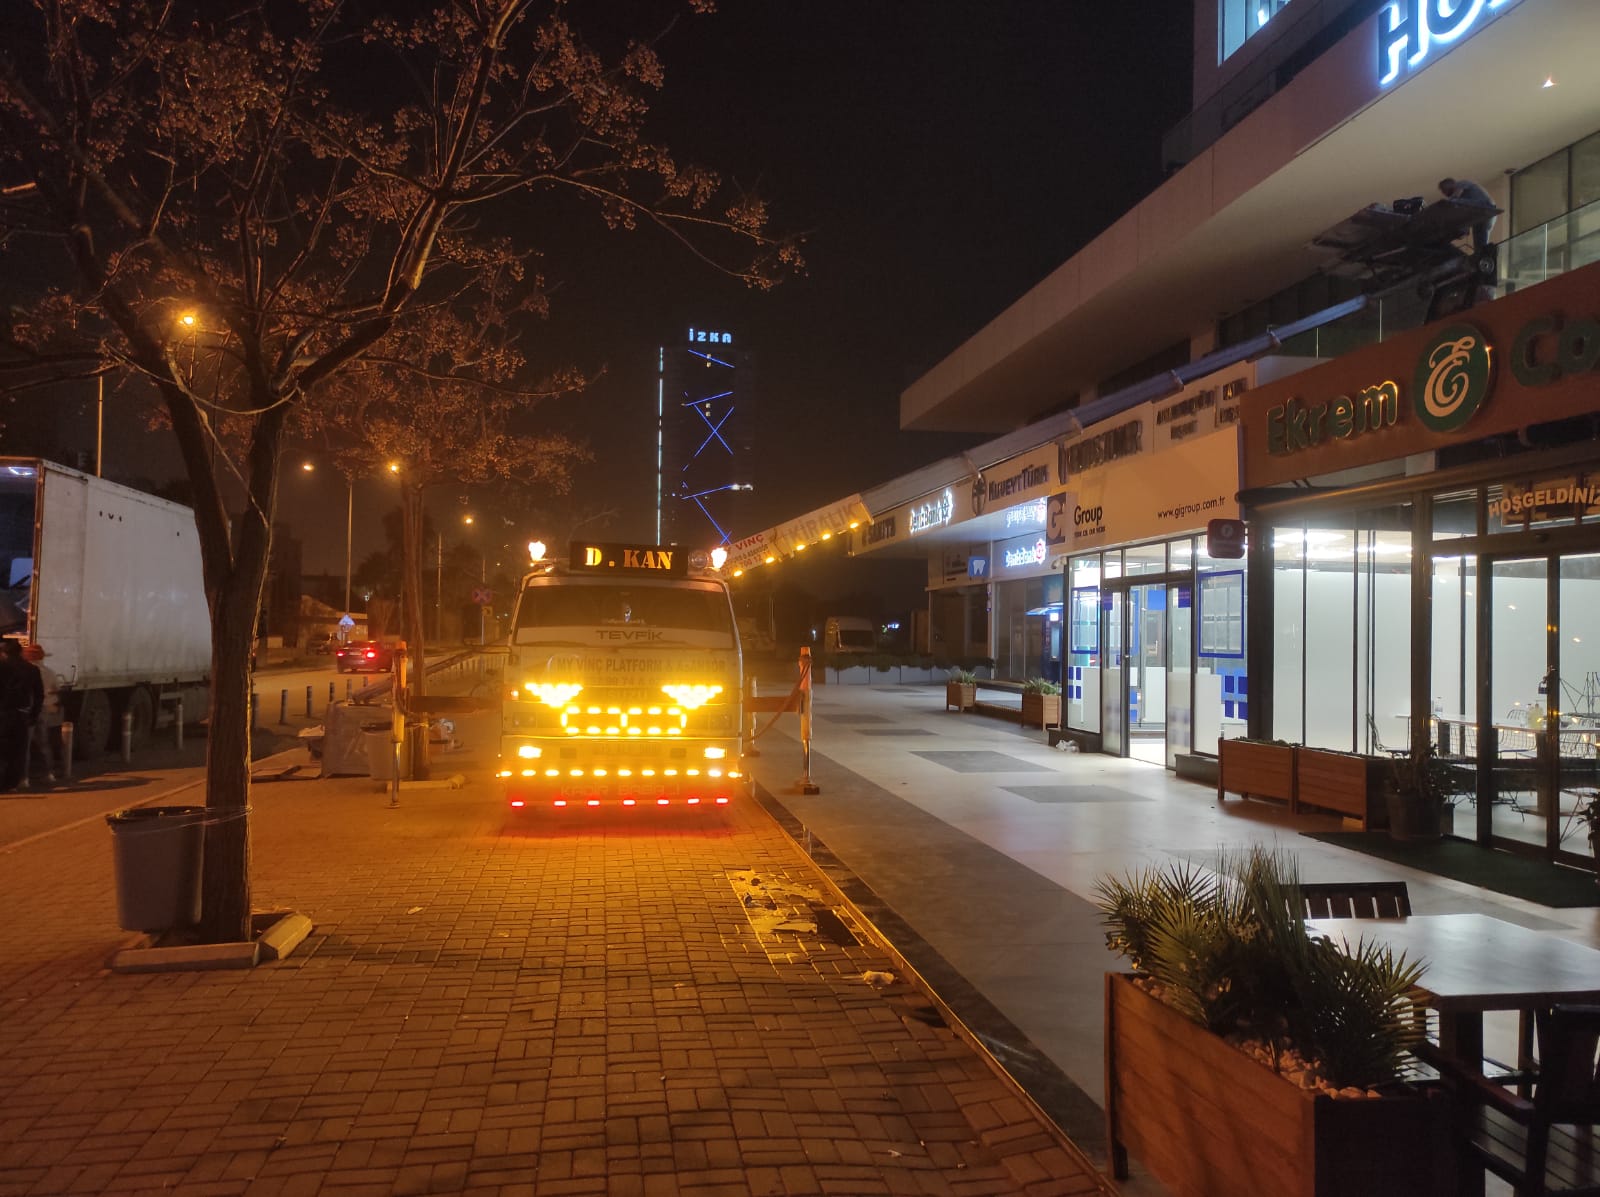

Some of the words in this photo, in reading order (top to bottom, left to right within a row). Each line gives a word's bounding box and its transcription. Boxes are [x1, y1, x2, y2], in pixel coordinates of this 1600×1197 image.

[1266, 379, 1399, 454] Ekrem
[1074, 505, 1103, 526] Group
[1157, 496, 1226, 519] www.gigroup.com.tr
[623, 550, 673, 570] KAN
[596, 629, 663, 642] TEVFİK
[606, 658, 662, 671] PLATFORM
